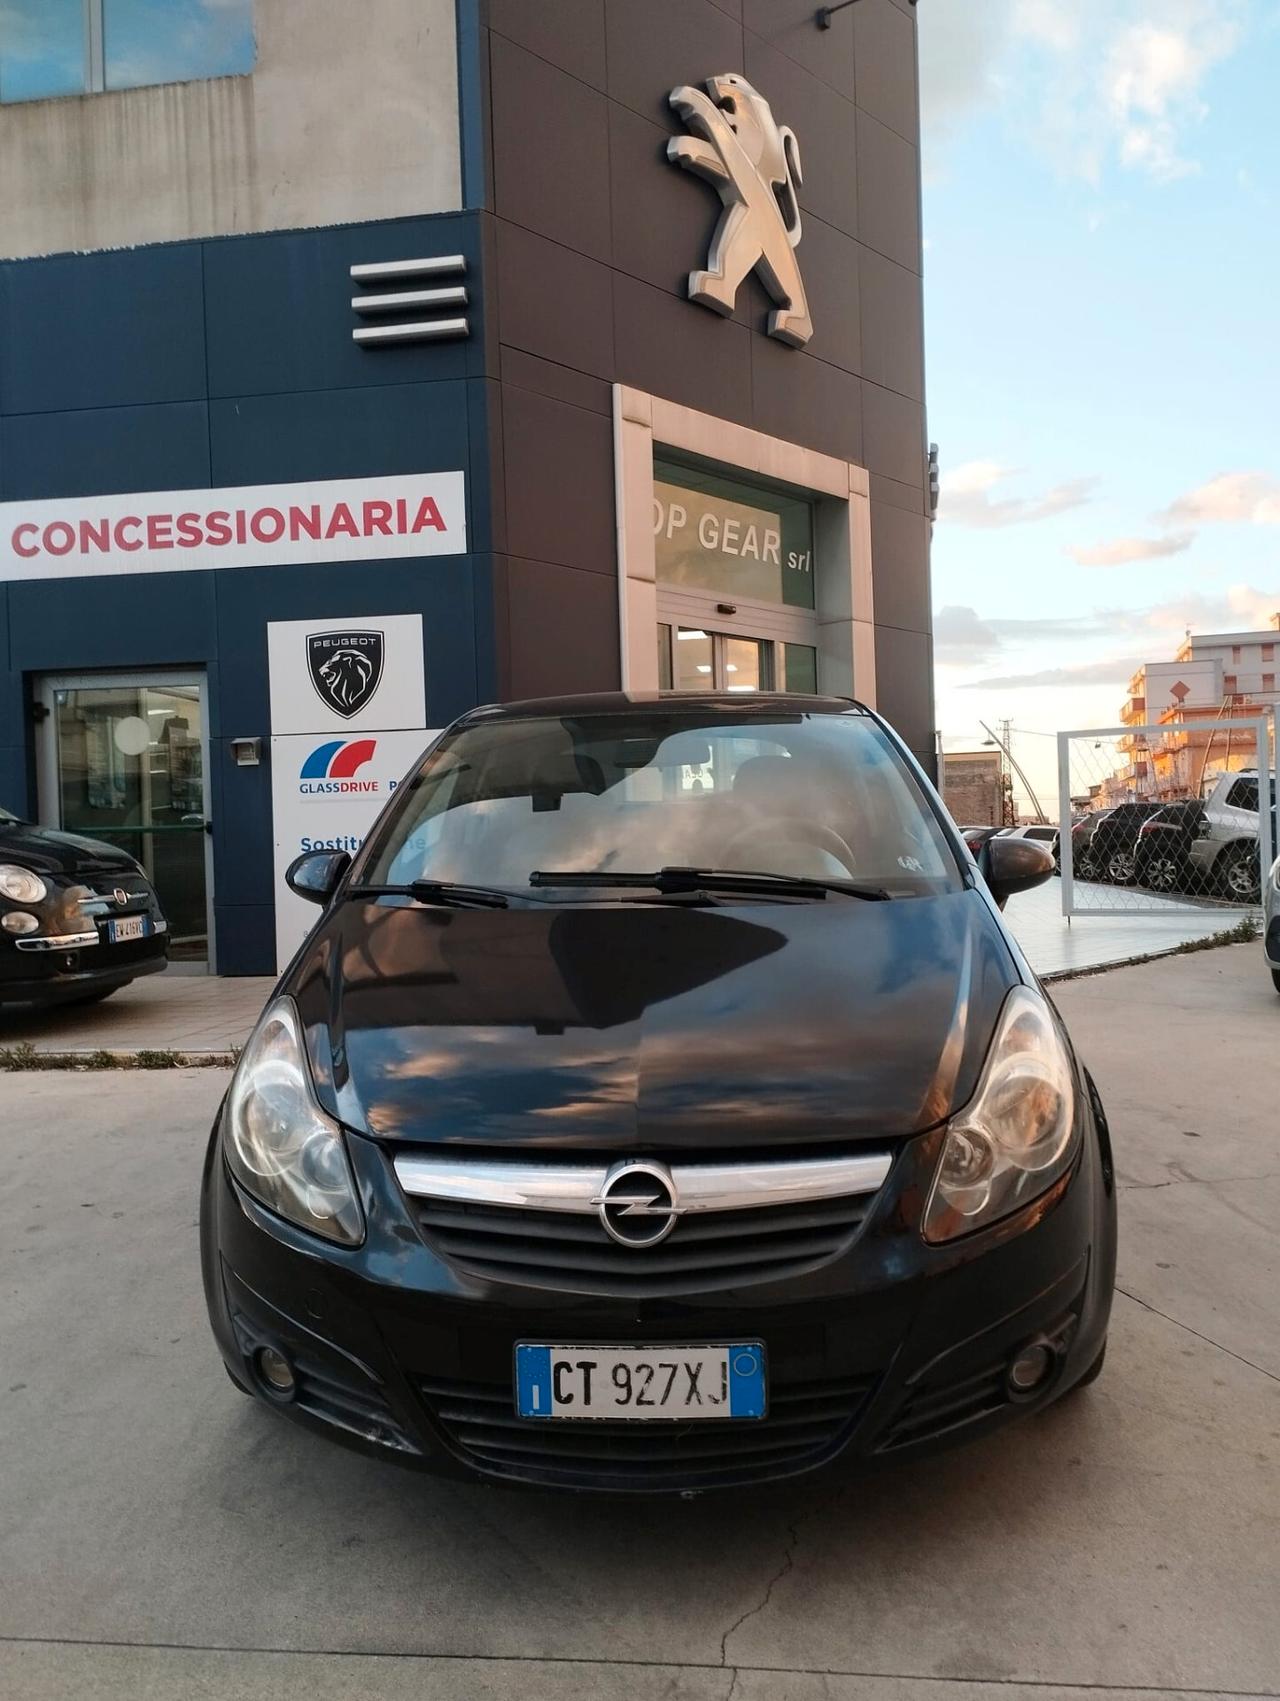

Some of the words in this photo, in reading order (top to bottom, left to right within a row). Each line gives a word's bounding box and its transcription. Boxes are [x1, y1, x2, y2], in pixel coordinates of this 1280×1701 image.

[11, 496, 447, 558] CONCESSIONARIA
[652, 498, 688, 539] OP
[698, 512, 781, 564] GEAR
[788, 550, 811, 572] srl
[313, 637, 377, 648] PEUGEOT
[299, 781, 379, 794] GLASSDRIVE
[553, 1361, 597, 1406] CT
[611, 1361, 728, 1406] 927XJ
